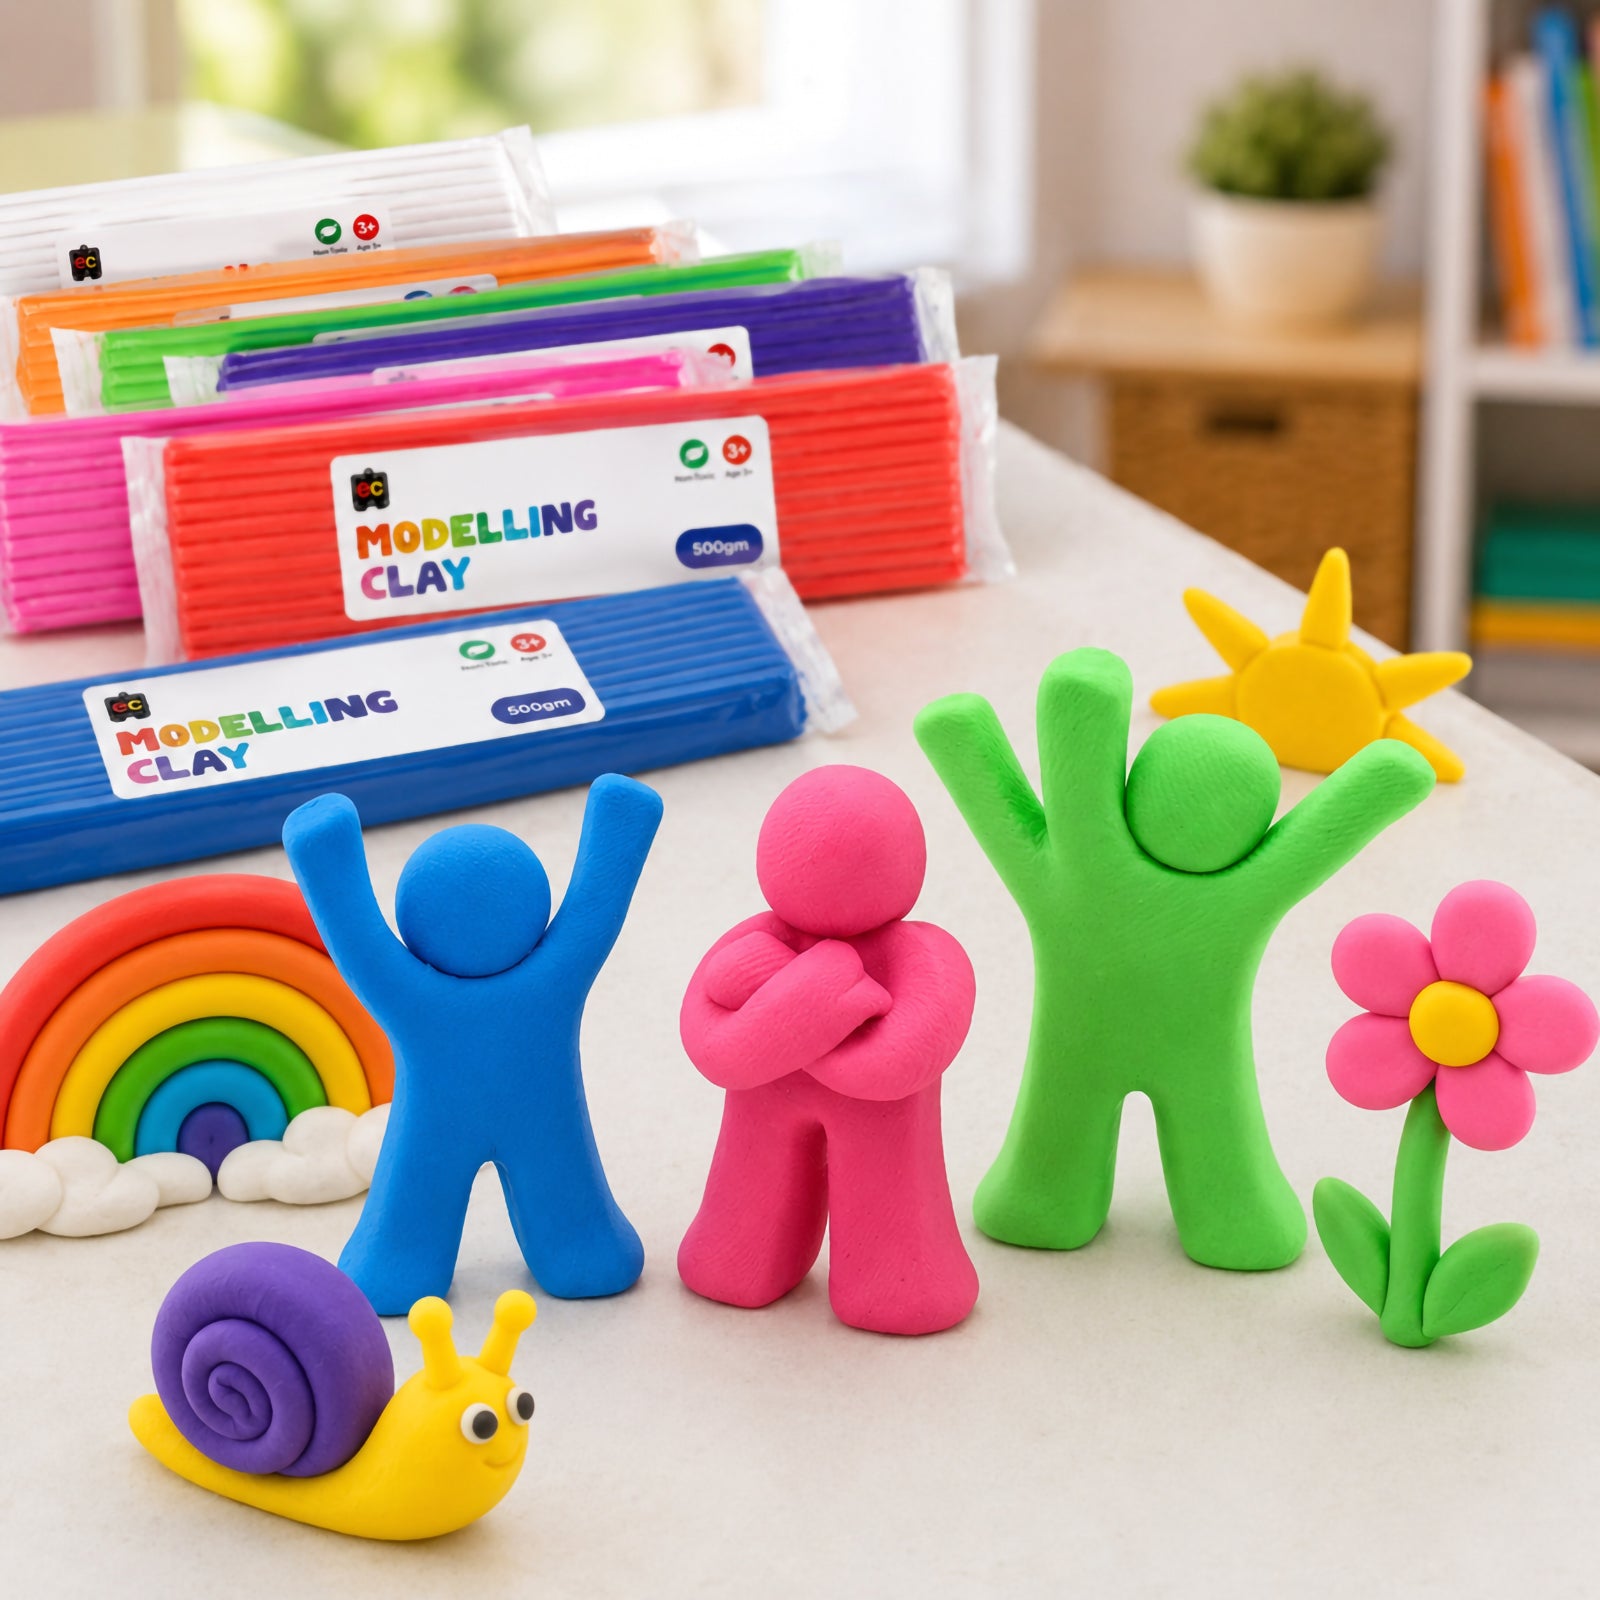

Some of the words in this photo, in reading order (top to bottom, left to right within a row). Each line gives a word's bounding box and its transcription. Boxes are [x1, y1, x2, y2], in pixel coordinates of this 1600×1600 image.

[357, 221, 376, 234] 3+
[74, 256, 97, 269] ec
[727, 443, 748, 459] 3+
[356, 481, 384, 498] ec
[356, 500, 598, 560] MODELLING
[692, 539, 750, 556] 500gm
[360, 556, 471, 600] CLAY
[516, 638, 540, 650] 3+
[507, 698, 572, 716] 500gm
[116, 690, 399, 756] MODELLING
[127, 742, 250, 785] CLAY
